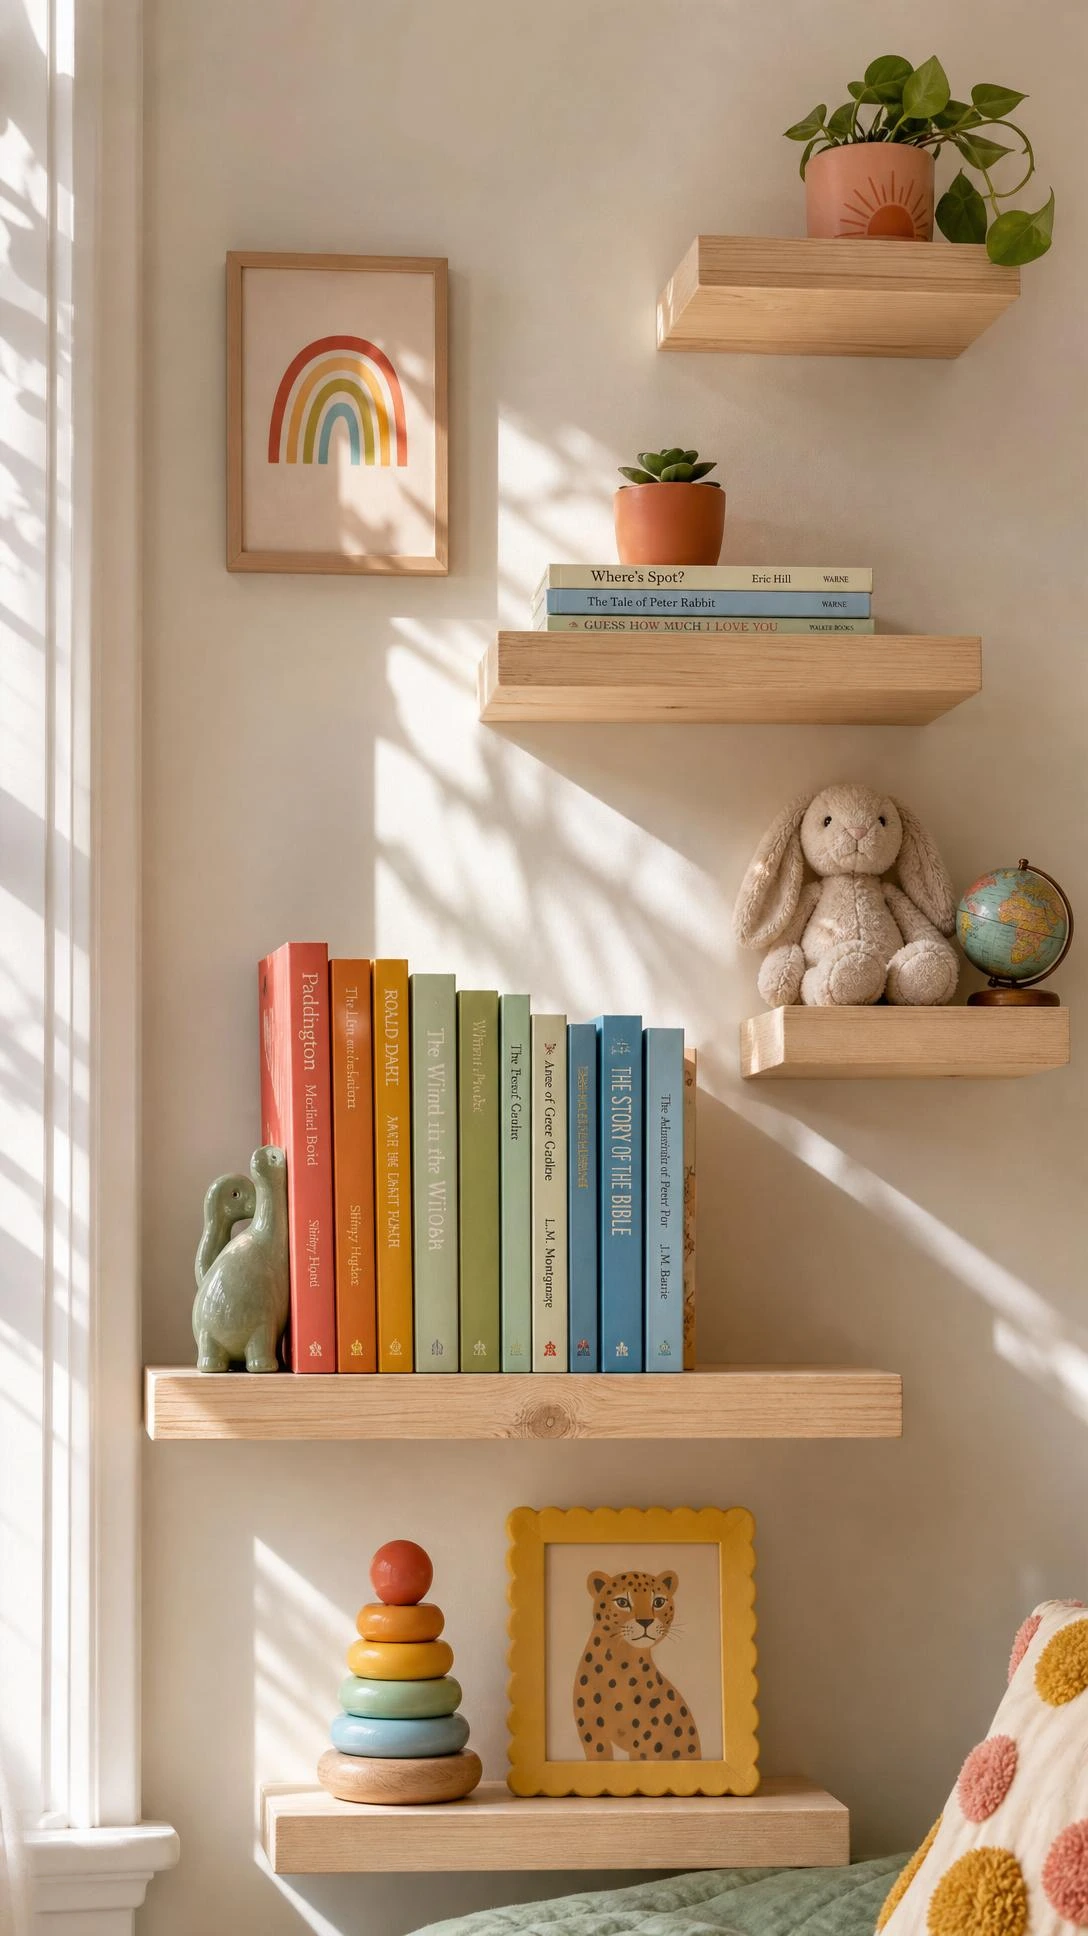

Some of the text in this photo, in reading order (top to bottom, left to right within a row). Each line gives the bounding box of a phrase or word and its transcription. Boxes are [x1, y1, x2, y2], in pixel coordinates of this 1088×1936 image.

[591, 570, 685, 585] Where's Spot?
[752, 574, 791, 584] Eric Hill
[587, 596, 715, 608] The Tale of Peter Rabbit
[584, 620, 778, 631] GUESS HOW MUCH I LOVE YOU
[299, 973, 320, 1071] Paddington
[384, 989, 399, 1039] ROALD
[511, 1044, 522, 1065] The
[544, 1091, 556, 1104] of
[660, 1094, 671, 1113] The
[611, 1066, 632, 1236] THE STORY OF THE BIBLE
